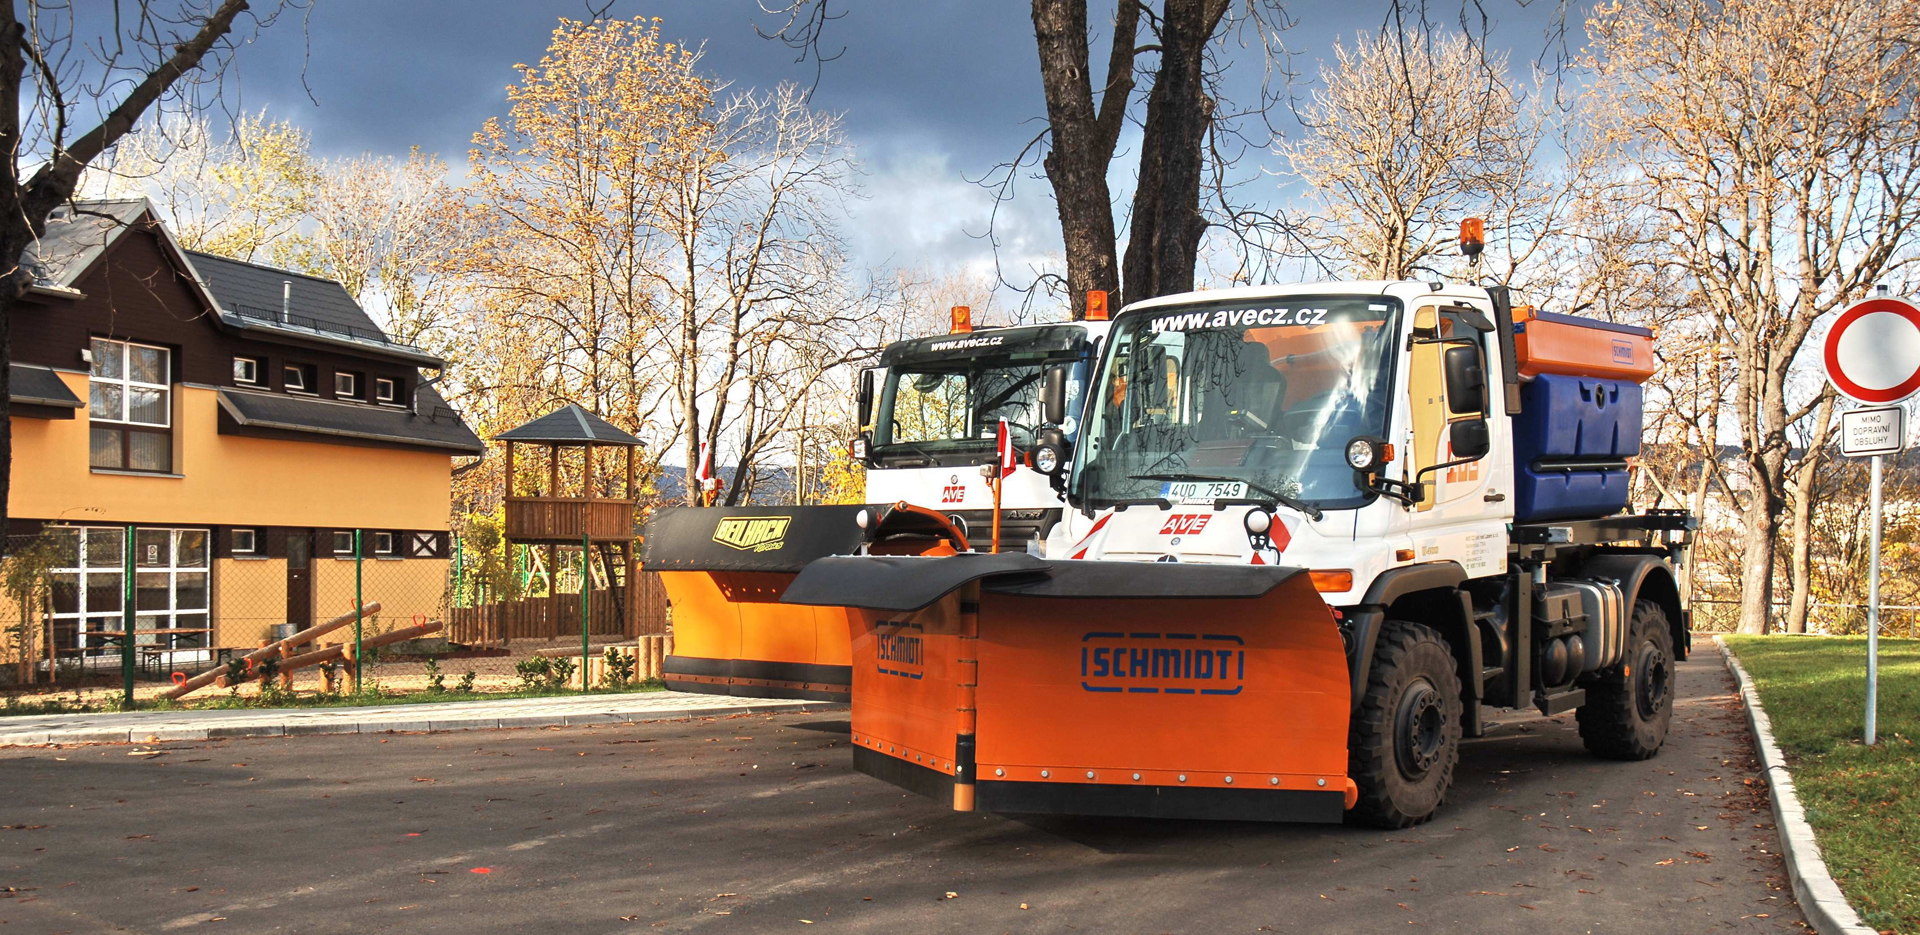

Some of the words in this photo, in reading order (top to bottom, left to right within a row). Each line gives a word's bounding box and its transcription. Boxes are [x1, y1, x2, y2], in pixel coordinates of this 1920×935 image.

[1151, 308, 1328, 334] www.avecz.cz
[931, 336, 1004, 352] www.avecz.cz
[1613, 345, 1632, 359] SCHMIDT
[1861, 415, 1882, 424] MIMO
[1853, 423, 1891, 436] DOPRAVNÍ
[1854, 436, 1889, 446] OBSLUHY
[942, 486, 965, 503] AVE
[1205, 483, 1241, 498] 7549
[1160, 515, 1211, 533] AVE
[715, 520, 789, 547] BEILHACK
[881, 633, 920, 665] SCHMIDT
[1093, 647, 1232, 679] SCHMIDT
